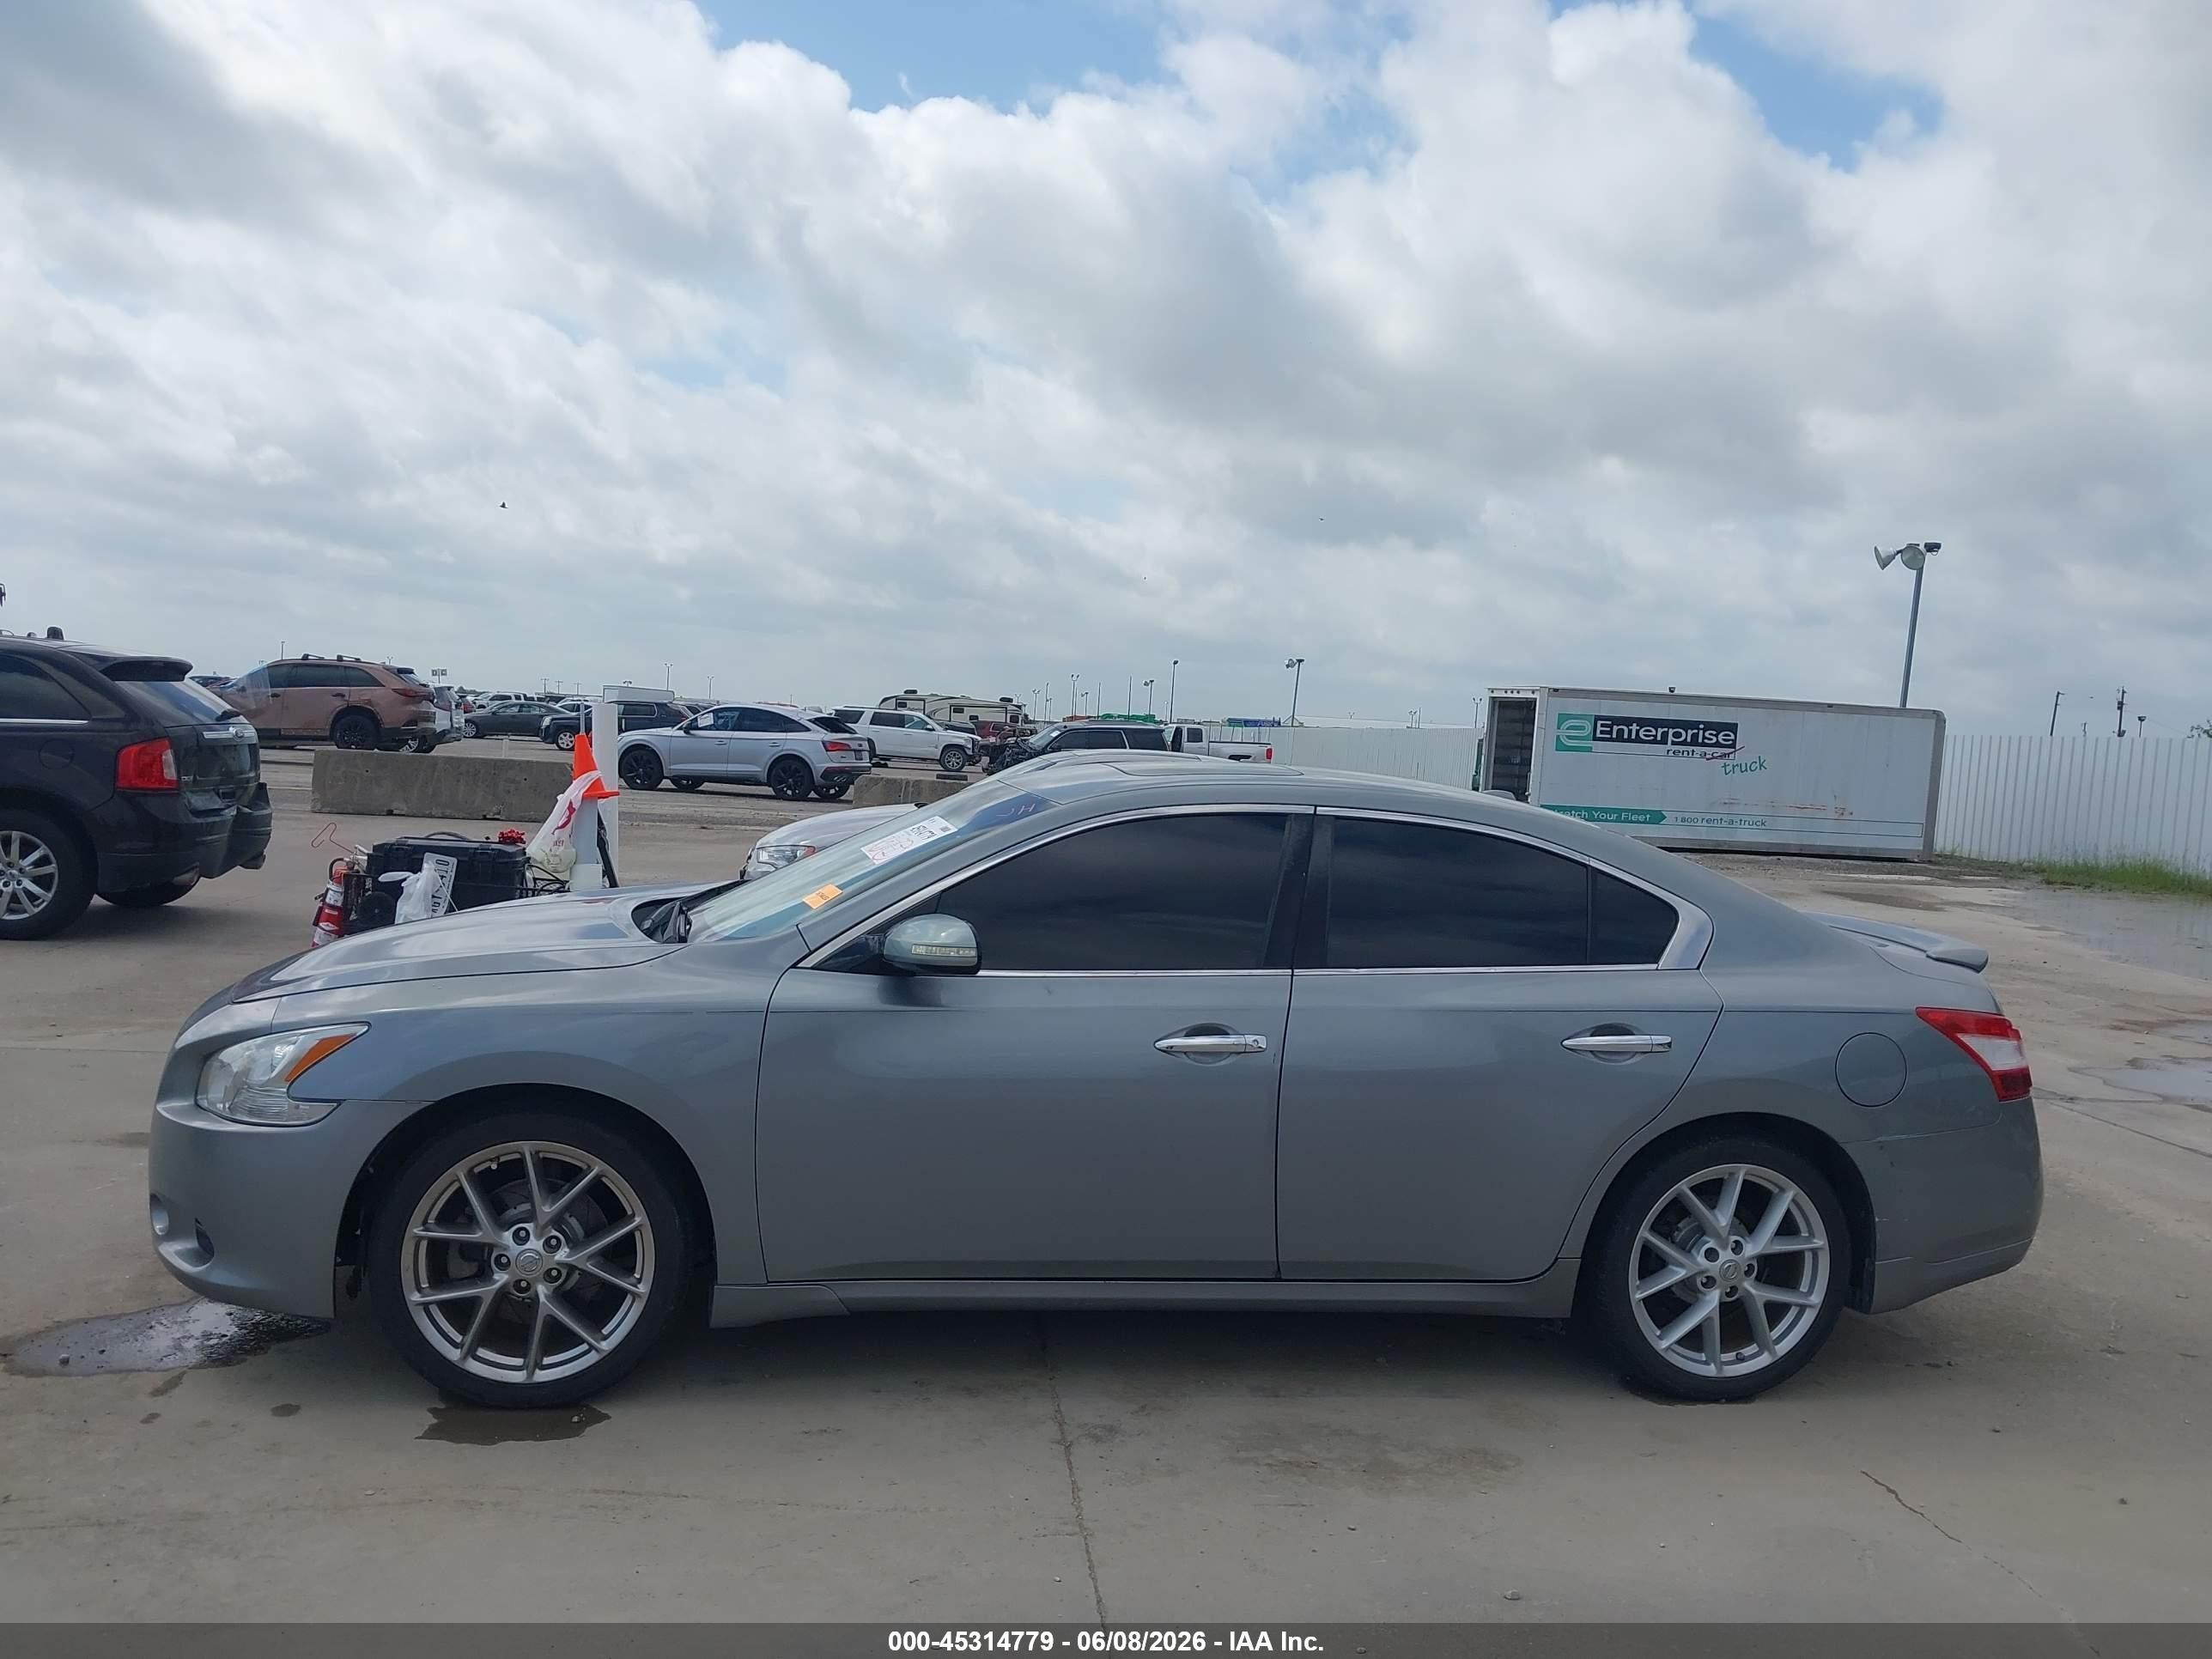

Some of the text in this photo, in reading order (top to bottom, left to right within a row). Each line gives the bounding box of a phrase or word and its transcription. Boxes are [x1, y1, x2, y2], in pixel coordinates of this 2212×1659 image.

[1595, 720, 1735, 745] Enterprise
[1721, 756, 1768, 775] truck
[1592, 810, 1619, 820] Your
[1621, 811, 1651, 822] Fleet
[1701, 817, 1767, 827] rent-a-truck
